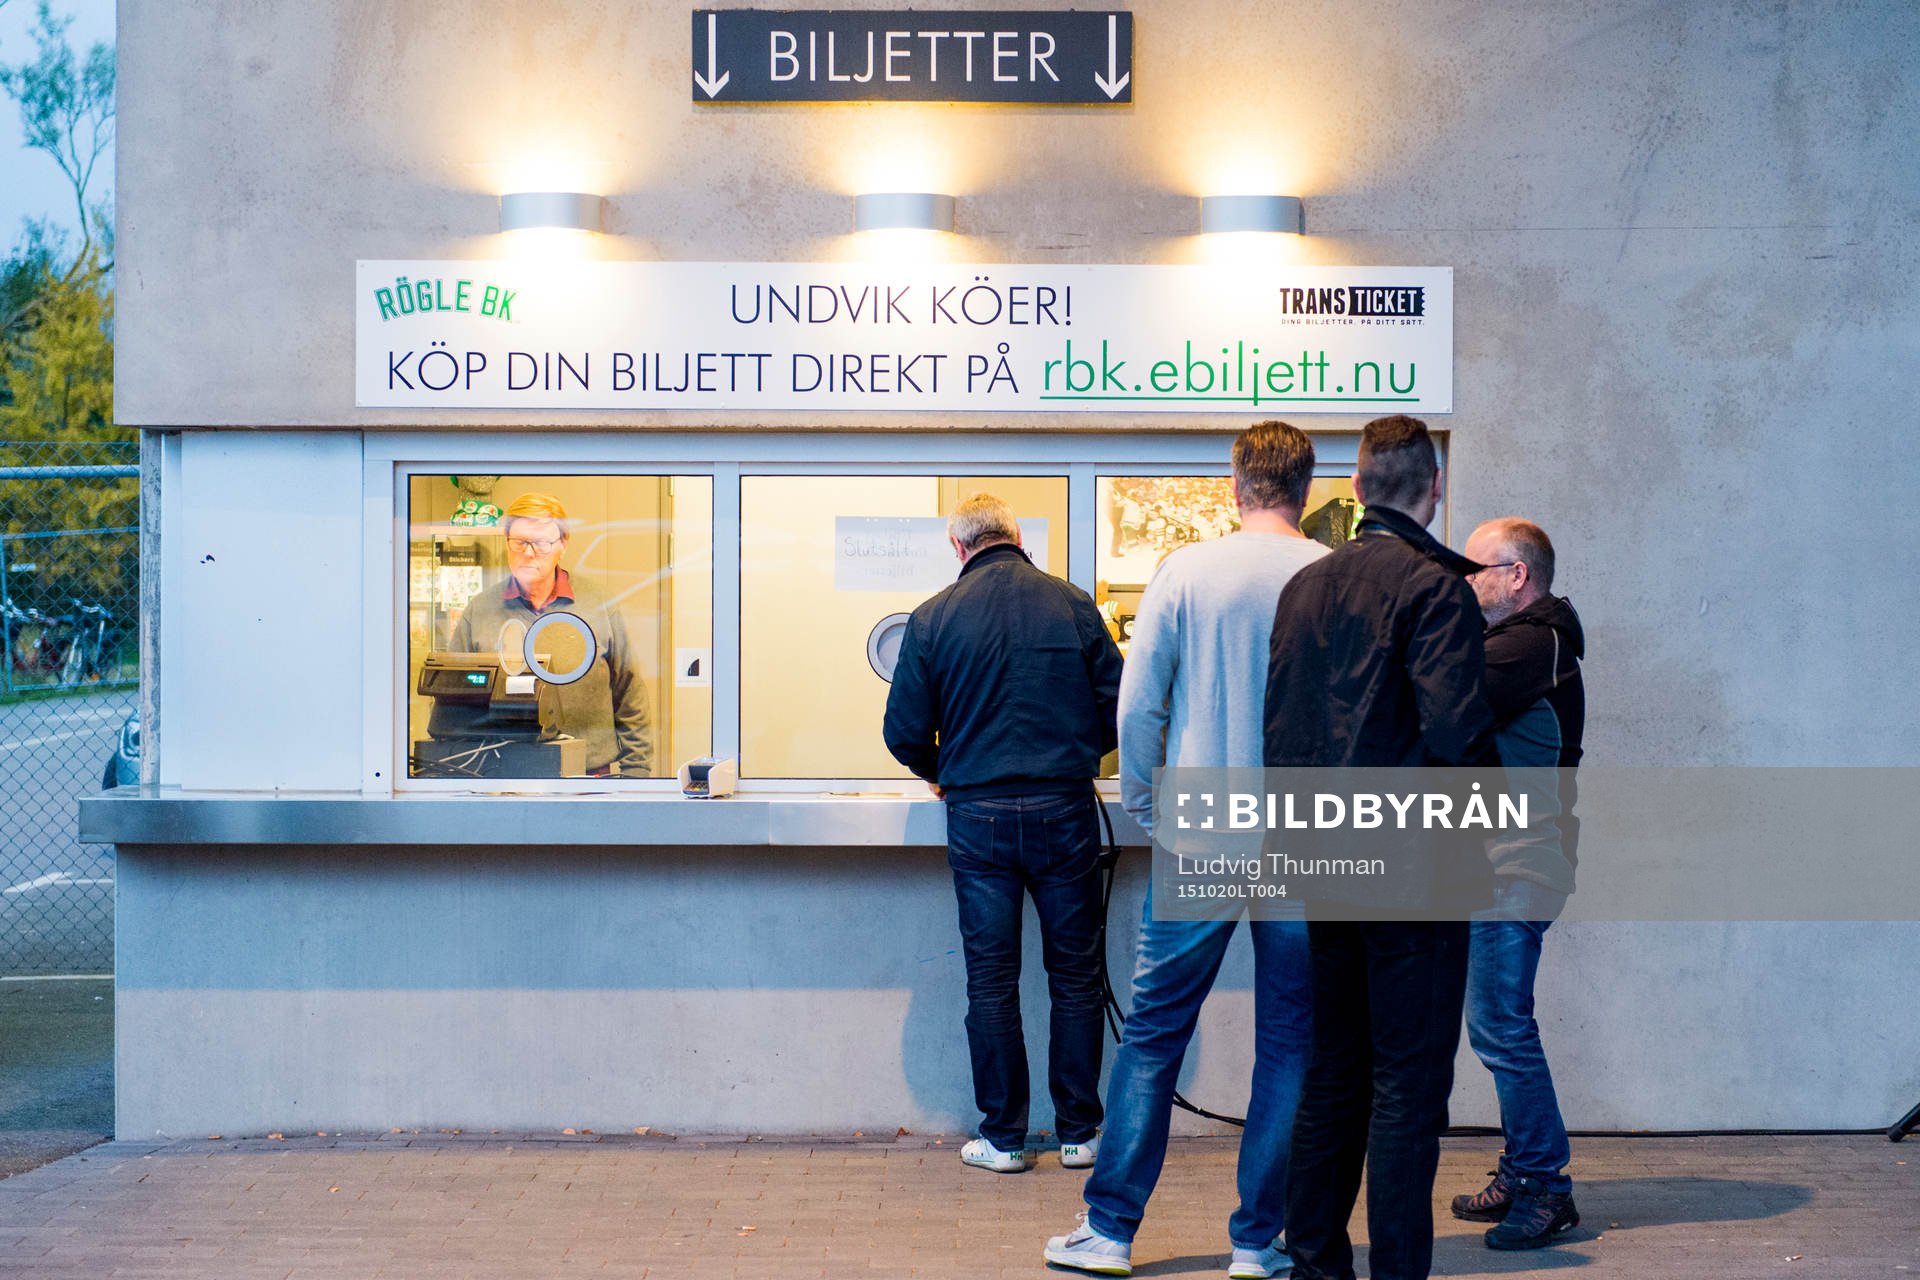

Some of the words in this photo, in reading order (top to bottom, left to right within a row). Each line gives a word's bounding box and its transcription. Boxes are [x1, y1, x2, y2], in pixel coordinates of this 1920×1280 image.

[770, 31, 1060, 82] BILJETTER
[374, 276, 472, 321] RÖGLE
[480, 285, 517, 322] BK
[730, 284, 911, 324] UNDVIK
[932, 276, 1072, 327] KÖER!
[1375, 318, 1396, 326] DITT
[388, 341, 487, 391] KÖP
[507, 351, 589, 391] DIN
[612, 352, 773, 393] BILJETT
[792, 353, 948, 393] DIREKT
[967, 342, 1020, 394] PÅ
[1043, 339, 1417, 406] rbk.ebiljett.nu
